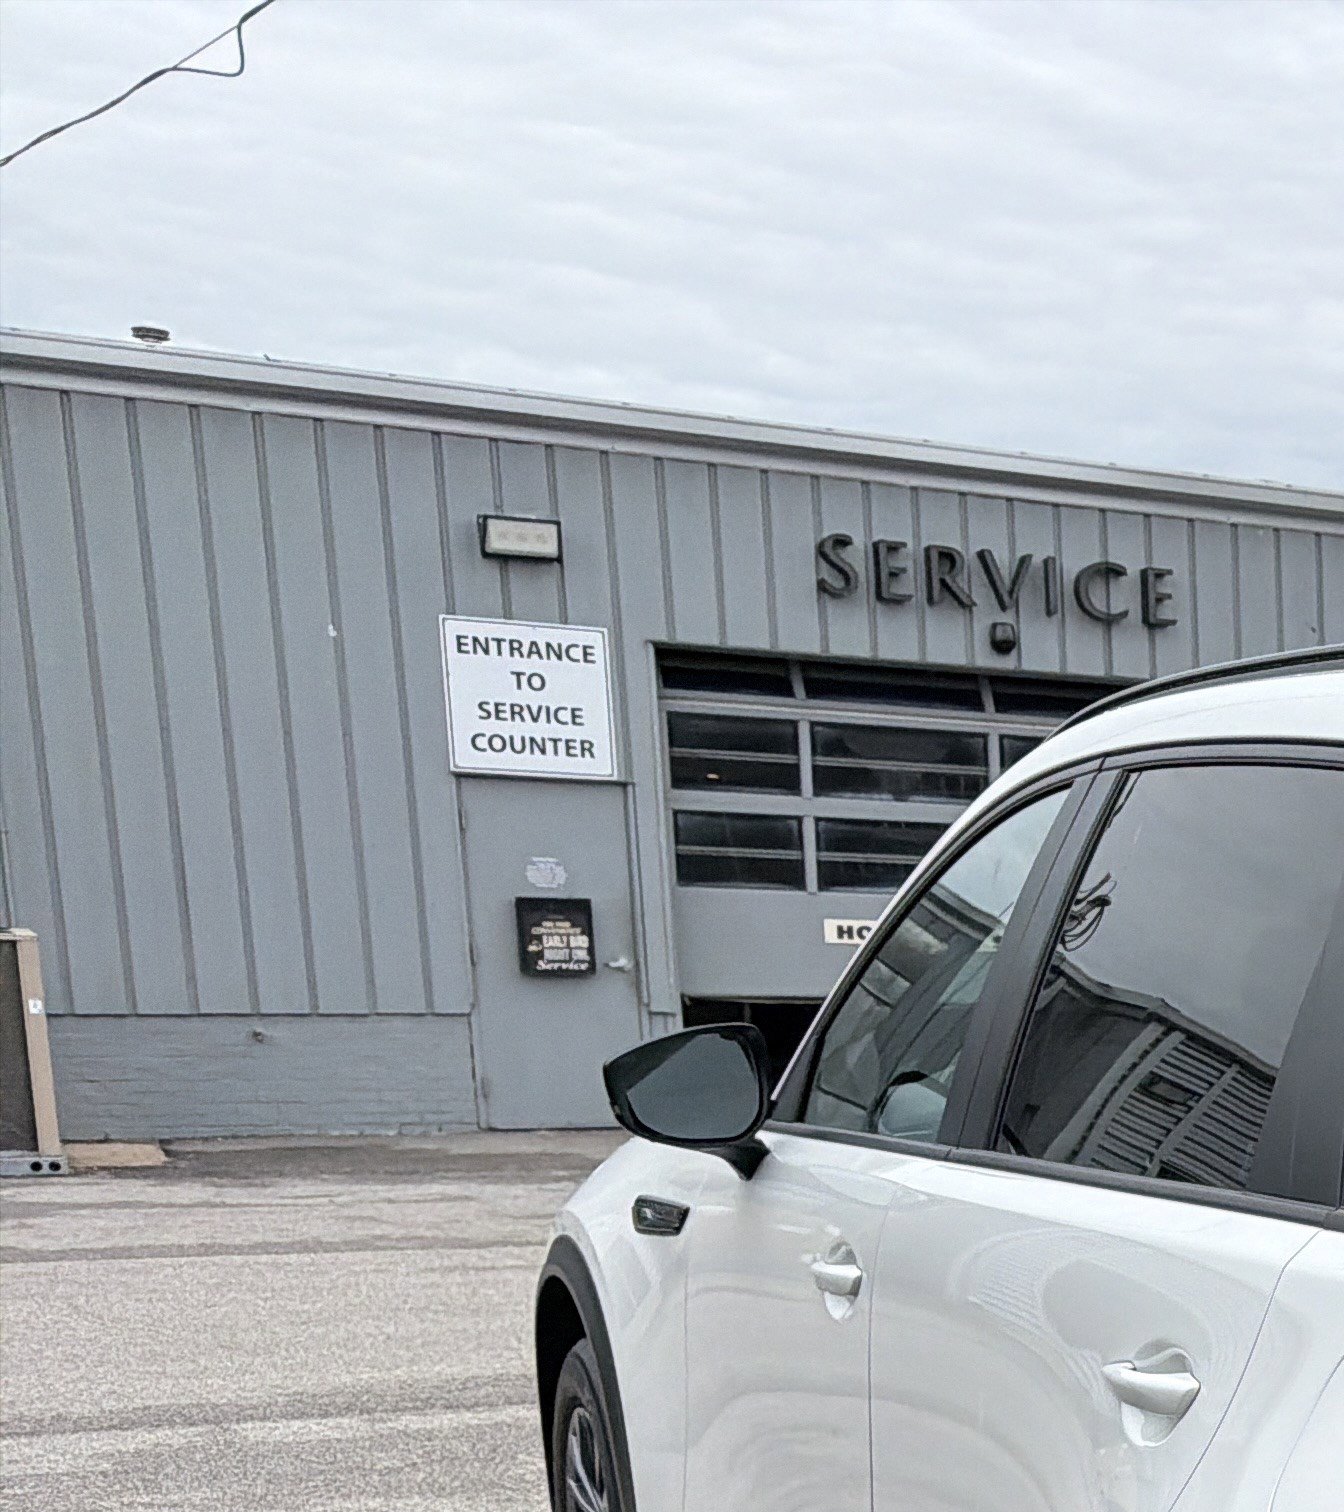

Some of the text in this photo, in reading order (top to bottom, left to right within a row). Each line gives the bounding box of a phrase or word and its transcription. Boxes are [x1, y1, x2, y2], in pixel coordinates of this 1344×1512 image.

[816, 532, 1179, 629] SERVICE
[455, 634, 597, 664] ENTRANCE
[510, 670, 546, 692] TO
[477, 701, 585, 727] SERVICE
[470, 732, 596, 760] COUNTER
[536, 959, 589, 971] Service
